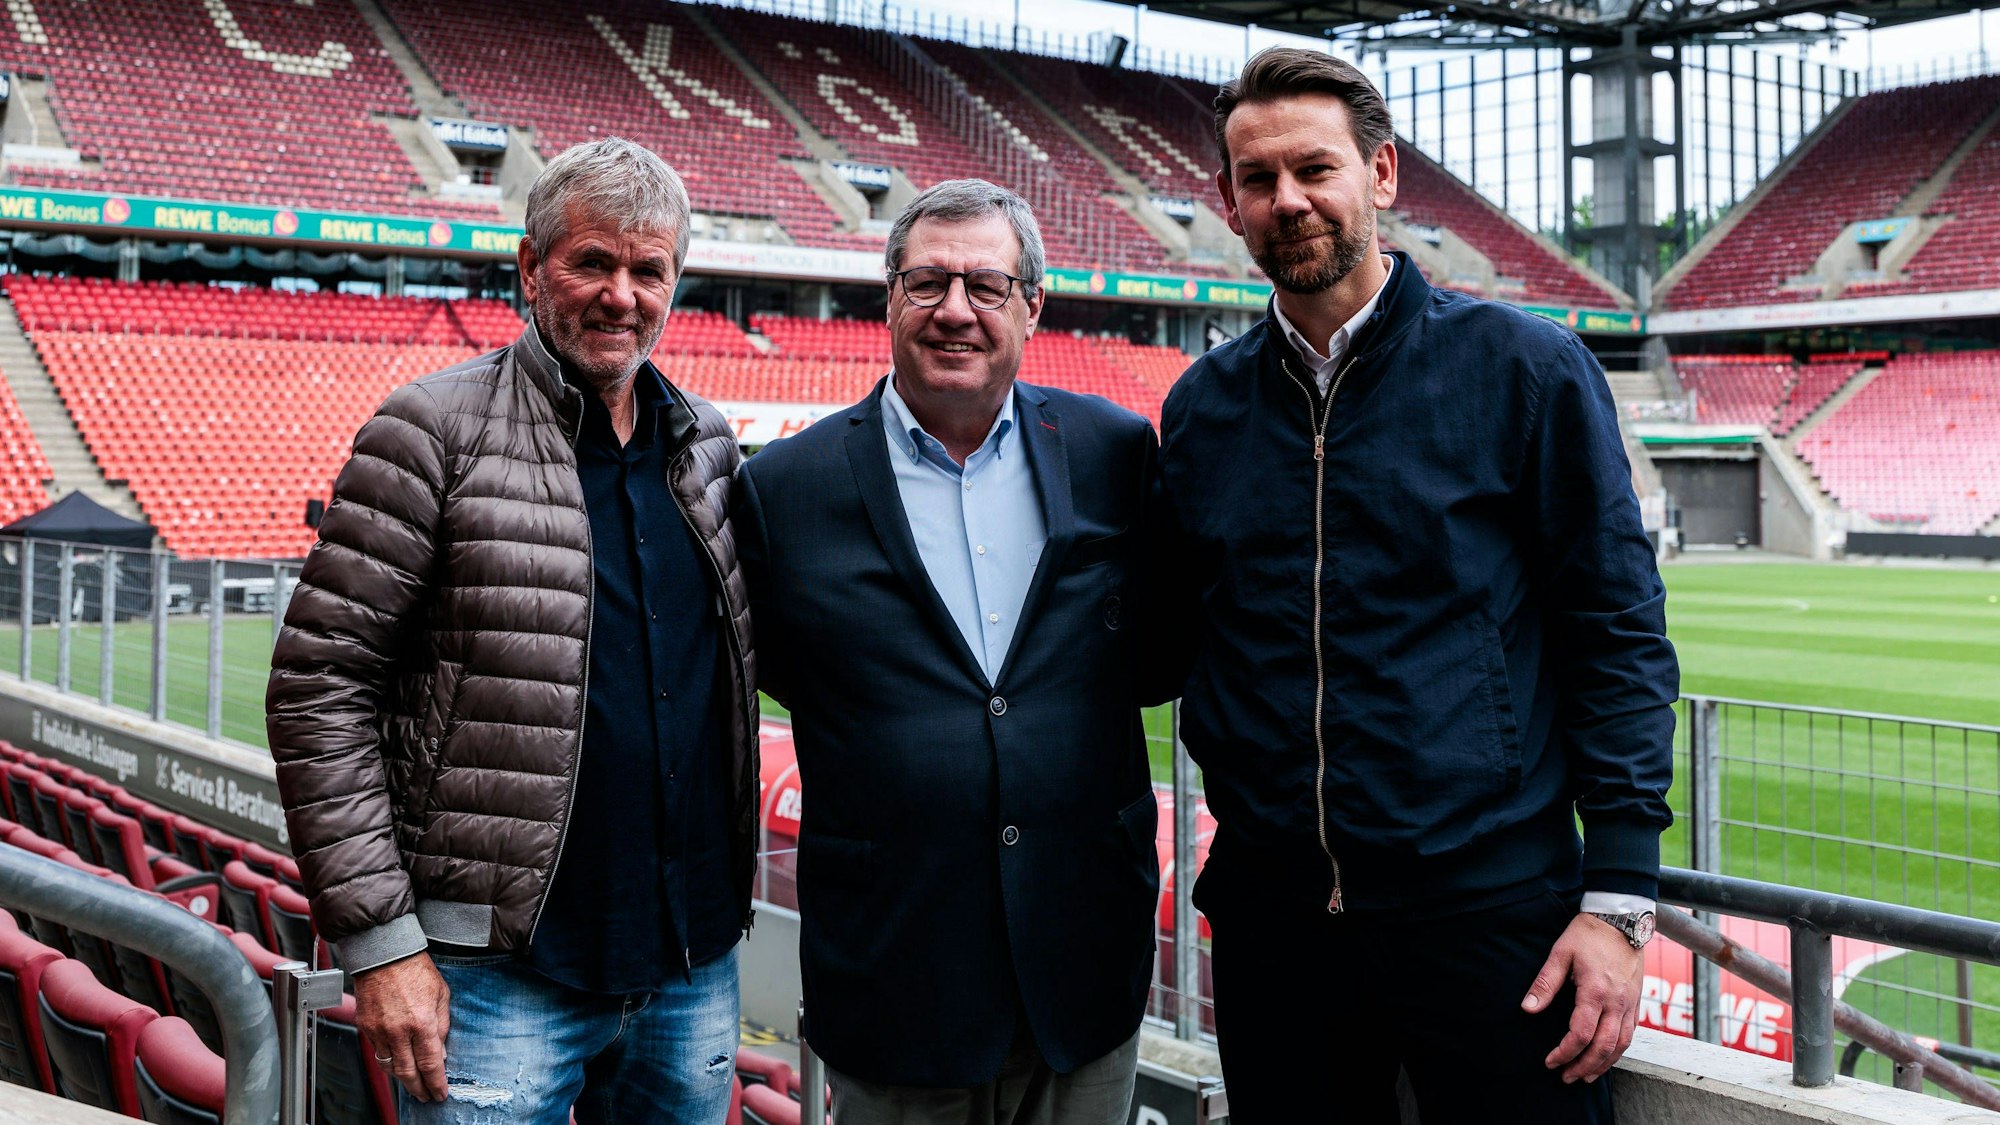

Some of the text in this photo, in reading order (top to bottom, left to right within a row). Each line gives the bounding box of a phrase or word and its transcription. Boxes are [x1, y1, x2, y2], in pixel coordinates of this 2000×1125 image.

[0, 194, 99, 223] WE Bonus
[154, 205, 270, 236] REWE Bonus
[319, 218, 426, 247] REWE Bonus
[471, 229, 520, 252] REWE
[41, 716, 138, 782] Individuelle Lösungen
[171, 760, 288, 844] Service & Beratung
